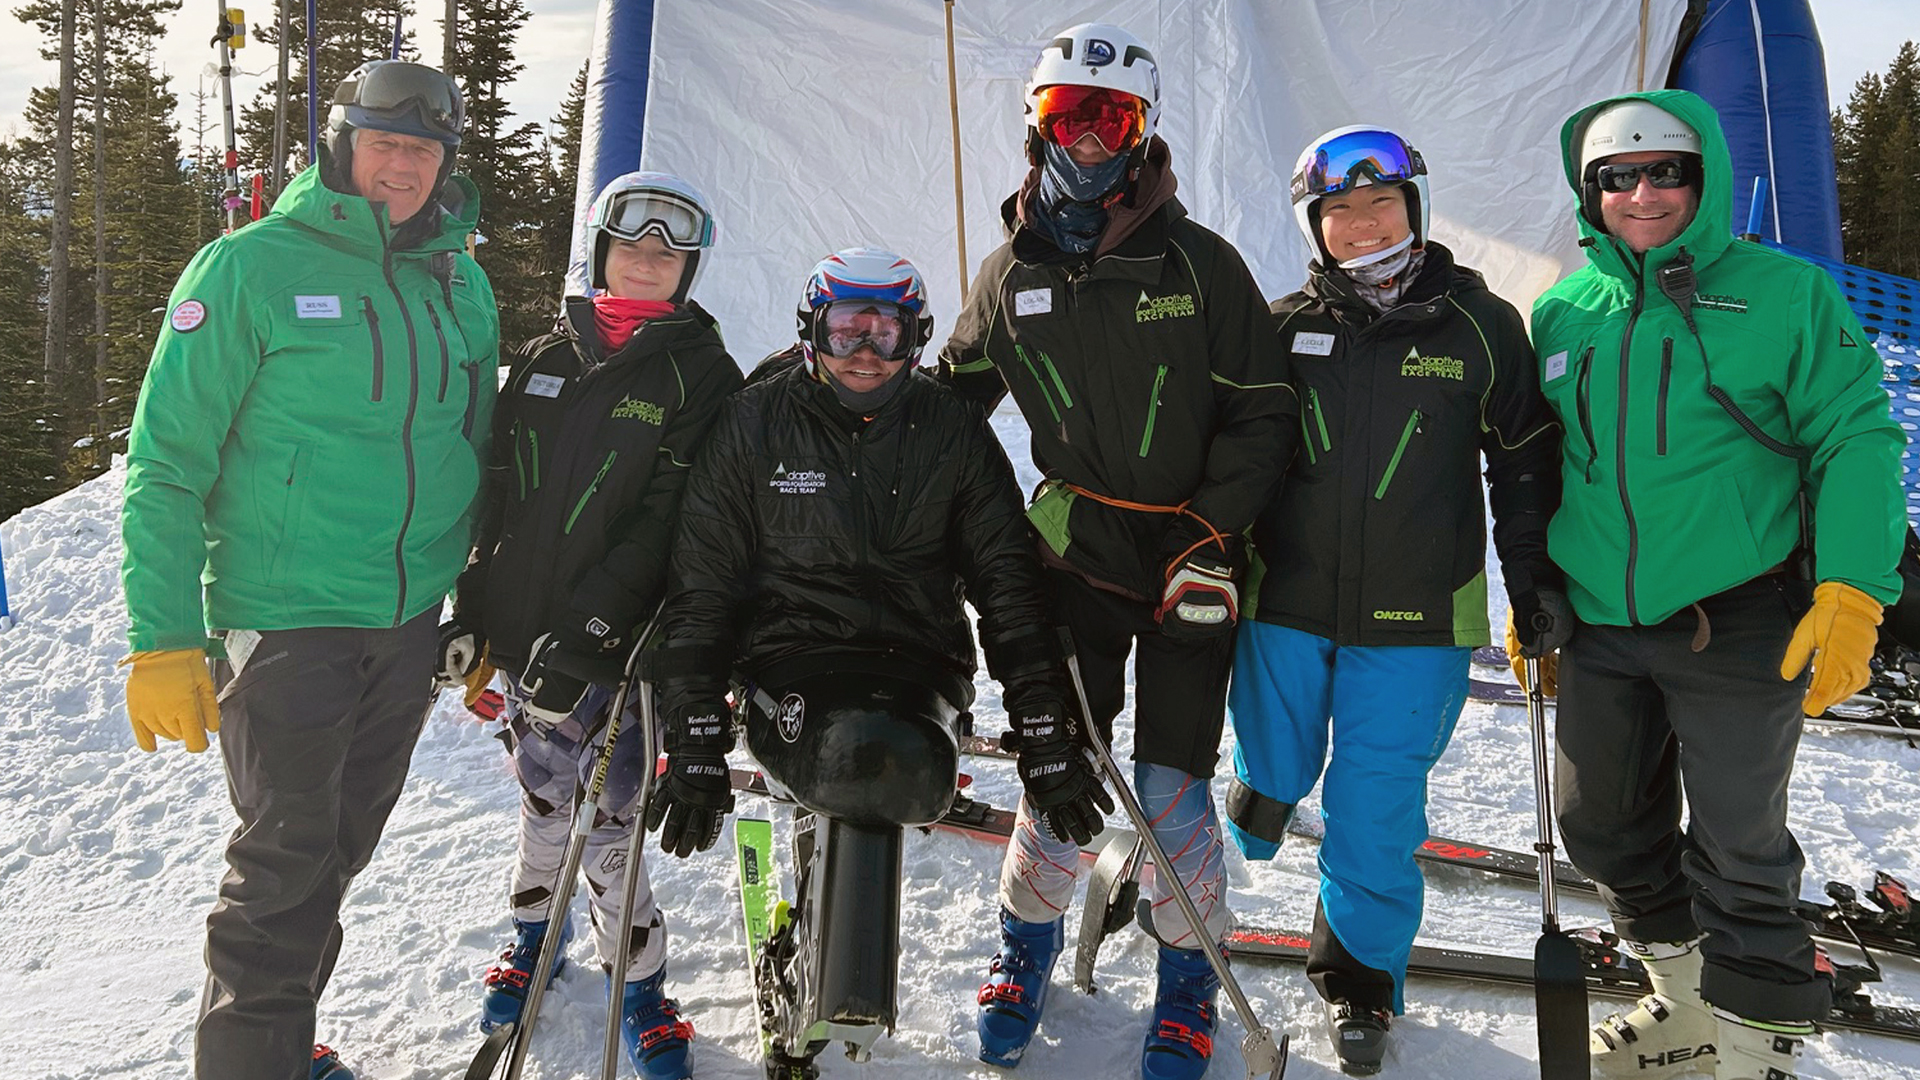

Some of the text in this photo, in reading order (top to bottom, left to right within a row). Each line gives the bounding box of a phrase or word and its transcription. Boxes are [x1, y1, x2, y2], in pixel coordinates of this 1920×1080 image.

[1136, 309, 1195, 323] RACE TEAM
[1436, 371, 1464, 381] TEAM
[637, 413, 663, 426] TEAM
[1183, 610, 1222, 619] LEKI
[704, 726, 722, 735] COMP
[1036, 726, 1055, 735] COMP
[592, 717, 622, 796] SUPERLITE
[686, 765, 725, 776] SKI TEAM
[1028, 762, 1068, 779] SKI TEAM
[1041, 811, 1063, 845] STRA
[1637, 1043, 1718, 1070] HEA
